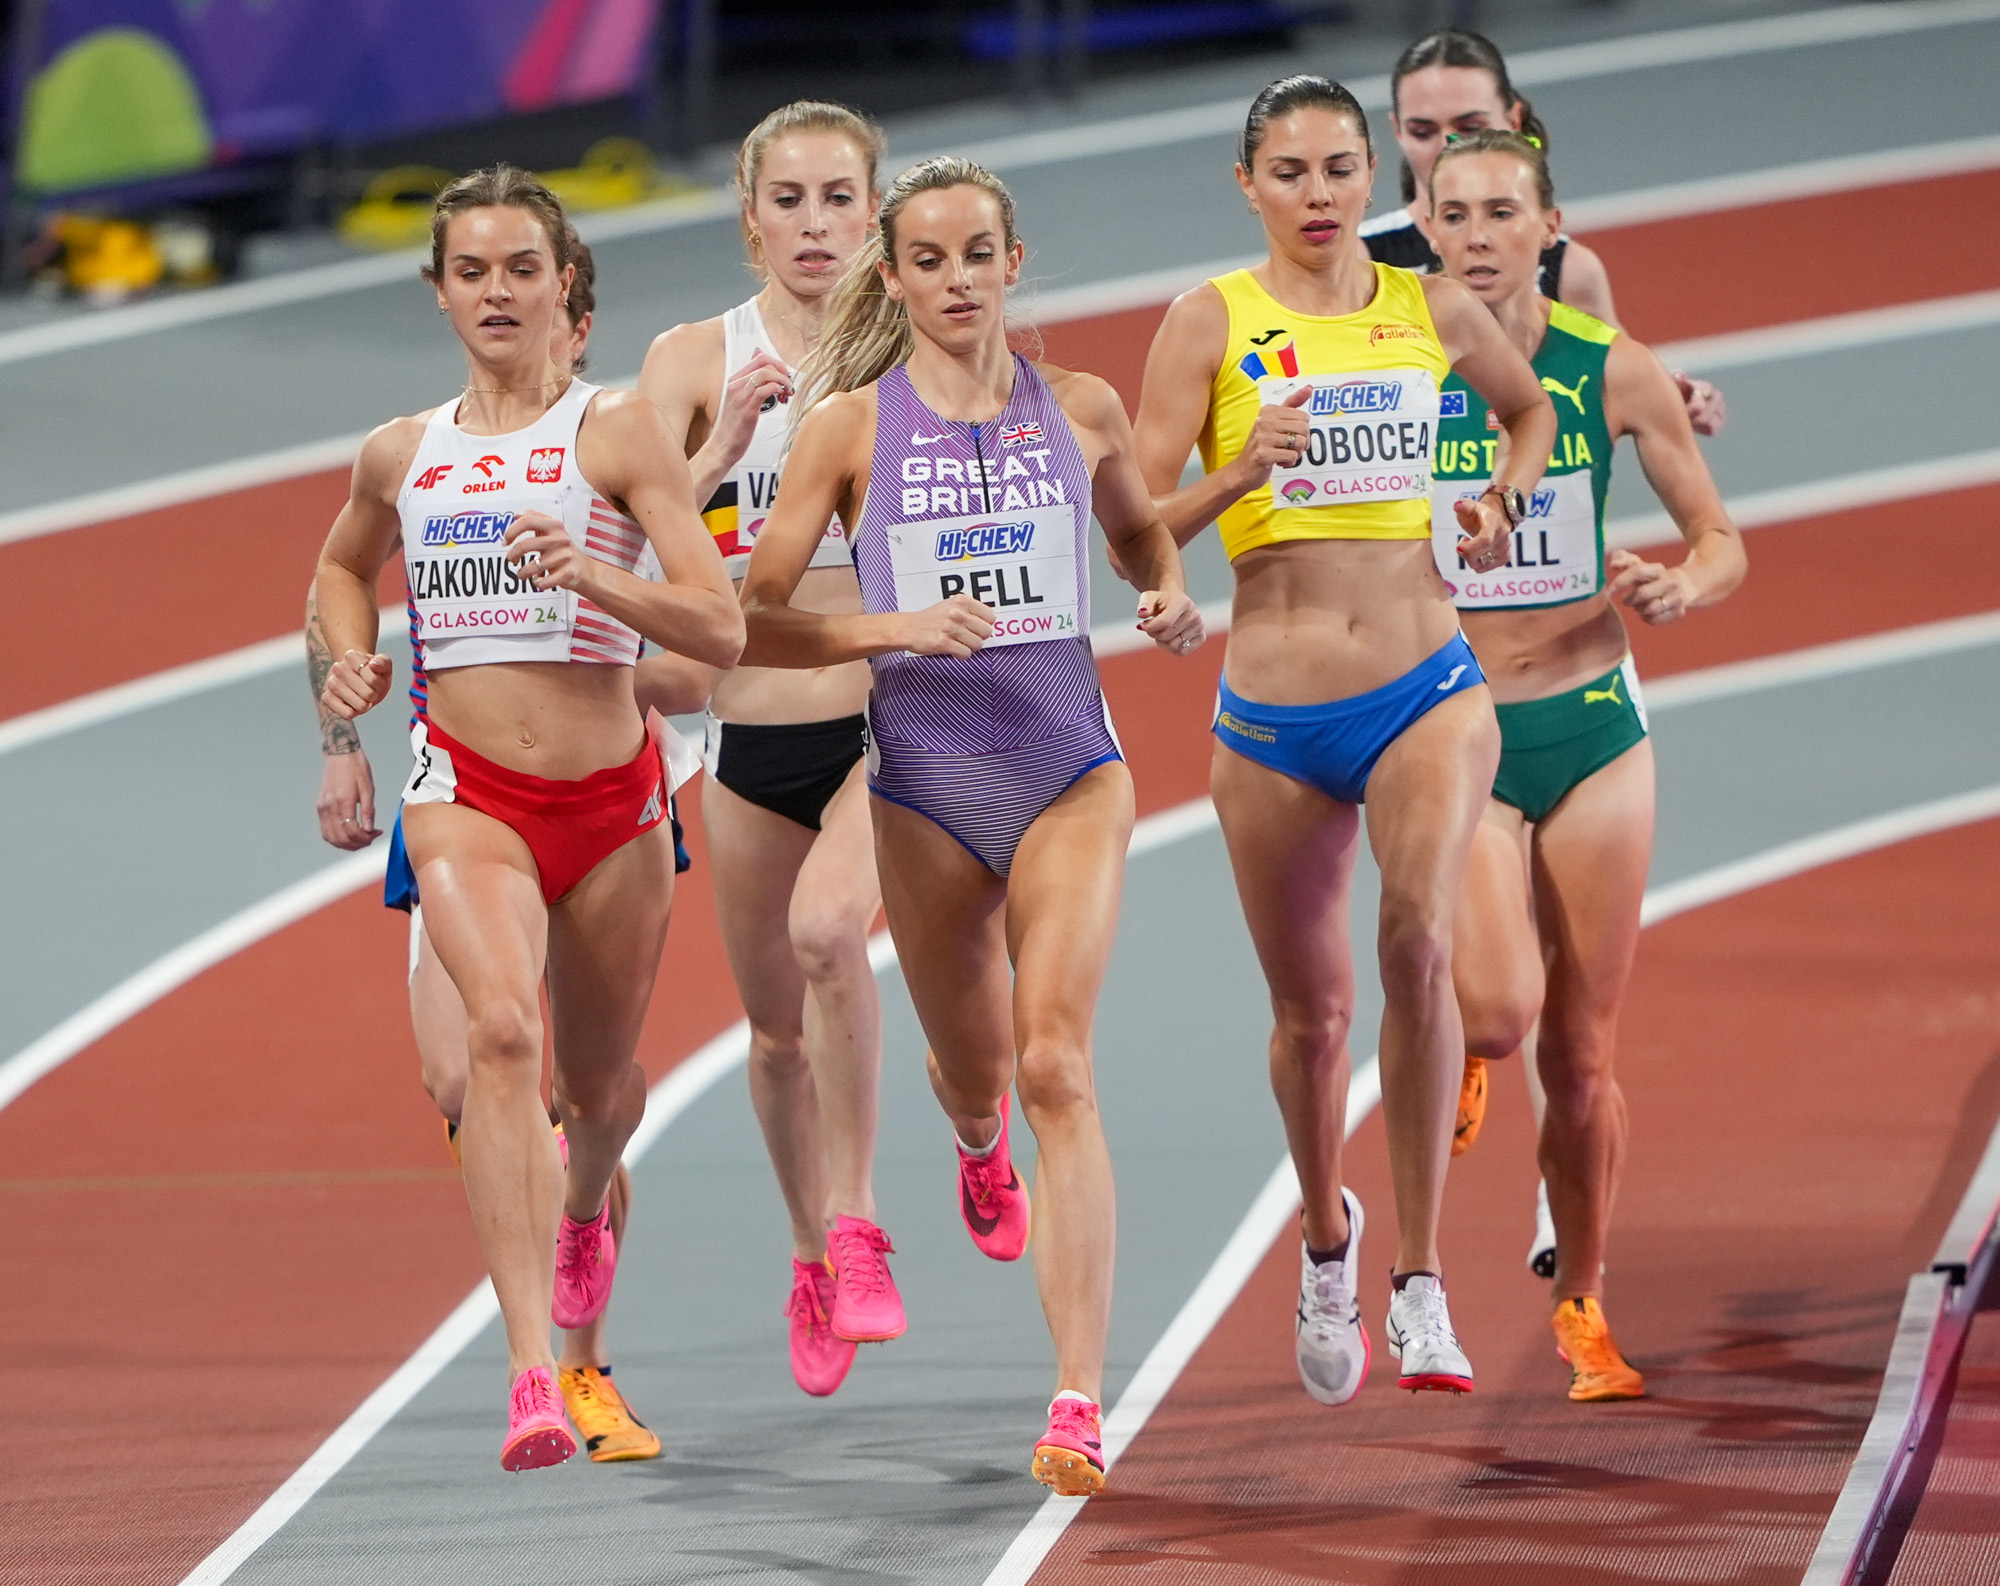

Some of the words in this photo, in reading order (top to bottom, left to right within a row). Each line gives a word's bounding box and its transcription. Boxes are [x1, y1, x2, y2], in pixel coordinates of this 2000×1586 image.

[1309, 381, 1402, 415] HI-CHEW
[1283, 421, 1429, 470] OBOCEA
[1432, 432, 1594, 474] USTLIA
[902, 448, 1051, 483] GREAT
[462, 480, 506, 494] ORLEN
[748, 471, 779, 510] VA
[902, 479, 1067, 515] BRITAIN
[1323, 475, 1412, 496] GLASGOW
[421, 511, 516, 546] HI-CHEW
[935, 521, 1035, 561] HI-CHEW
[410, 553, 557, 600] ZAKOWSK
[939, 565, 1044, 608] BELL
[1465, 576, 1567, 599] GLASGOW
[1570, 571, 1590, 589] 24
[429, 607, 529, 629] GLASGOW
[534, 606, 558, 623] 24
[989, 615, 1053, 638] SGOW
[1056, 613, 1073, 631] 24
